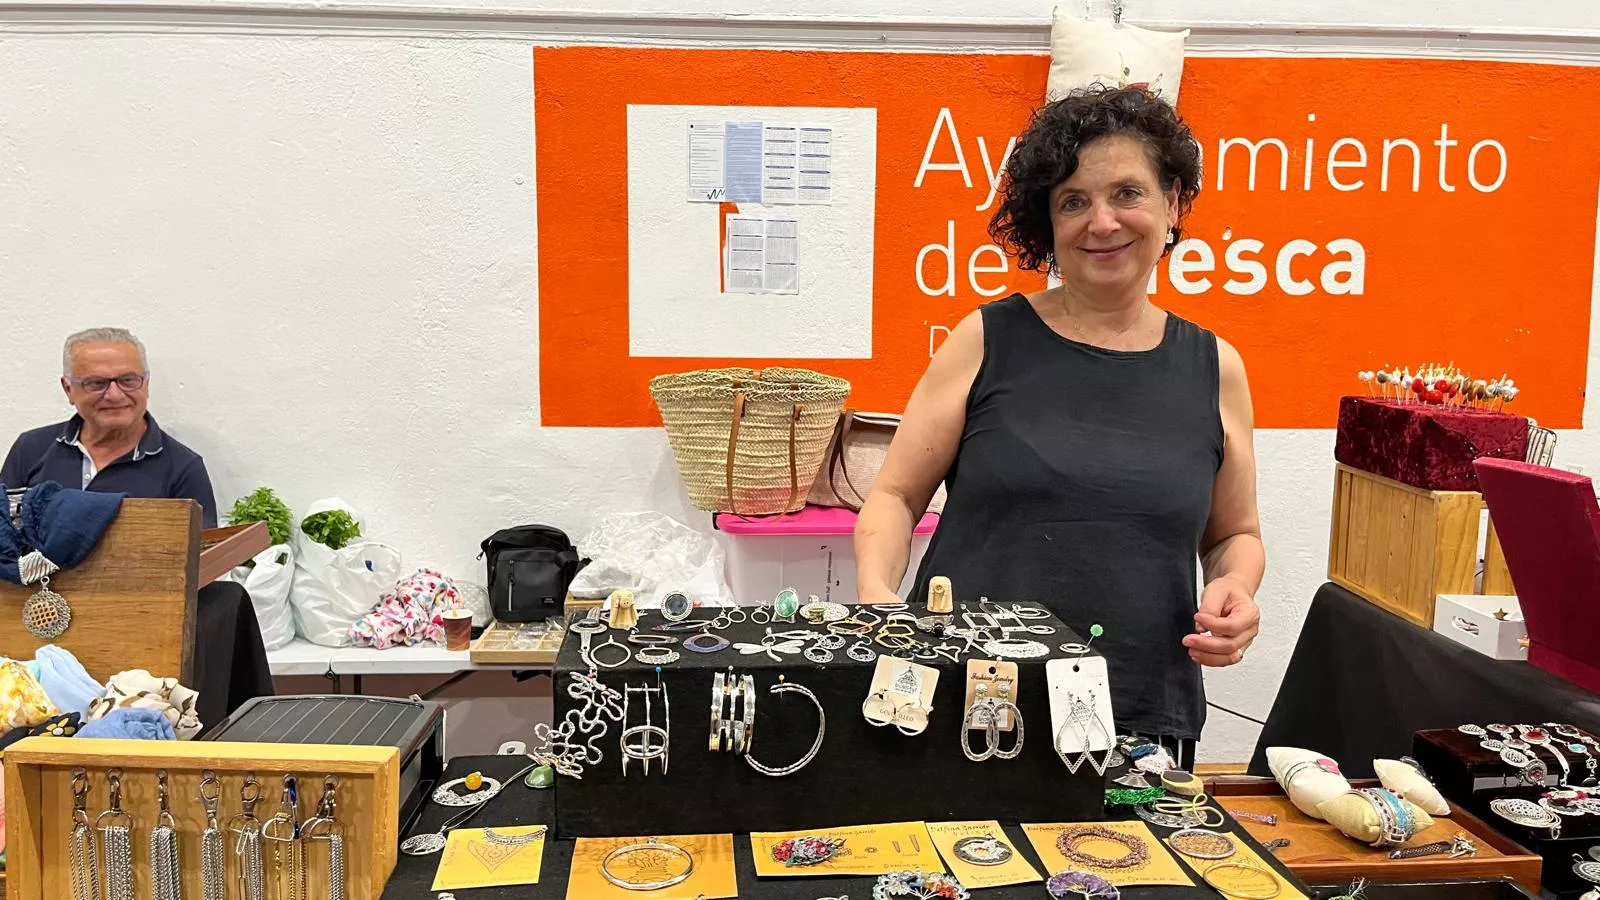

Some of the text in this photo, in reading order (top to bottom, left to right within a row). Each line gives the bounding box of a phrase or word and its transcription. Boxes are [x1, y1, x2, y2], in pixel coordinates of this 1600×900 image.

[913, 107, 1508, 212] Aymiento
[915, 220, 1366, 297] de esca
[970, 672, 993, 681] Fashion
